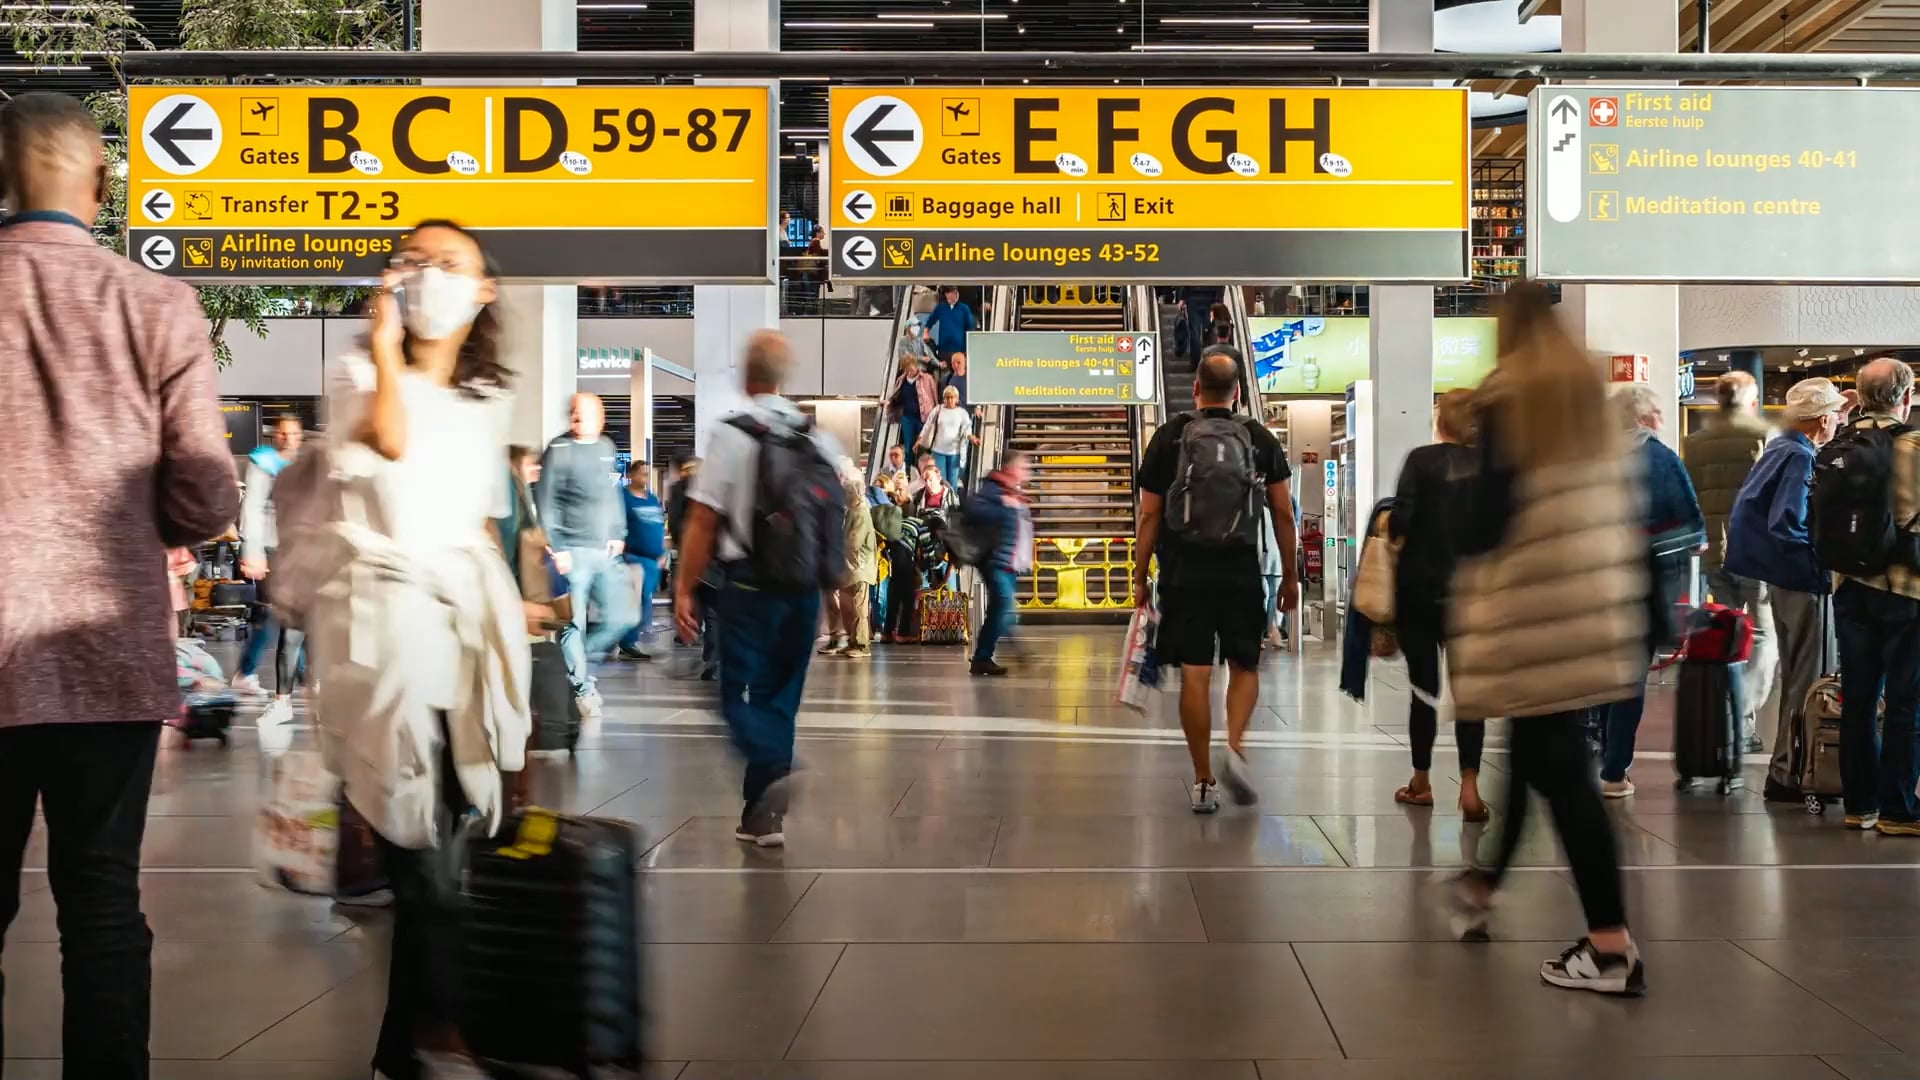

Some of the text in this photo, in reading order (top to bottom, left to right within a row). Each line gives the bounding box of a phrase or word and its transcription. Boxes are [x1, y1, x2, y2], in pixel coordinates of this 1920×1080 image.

[1625, 92, 1712, 112] First aid
[1625, 115, 1704, 130] Eerste hulp
[240, 95, 752, 175] Gates B C D 59-87
[941, 96, 1331, 175] Gates E F G H
[1626, 149, 1857, 173] Airline lounges 40-41
[221, 190, 400, 221] Transfer T2-3
[922, 196, 1062, 218] Baggage hall
[1133, 196, 1174, 214] Exit
[1625, 196, 1821, 215] Meditation centre
[220, 234, 392, 257] Airline lounges
[920, 242, 1160, 266] Airline lounges 43-52
[220, 255, 344, 271] By invitation only
[1069, 334, 1114, 345] First aid
[1075, 345, 1114, 354] Eerste hulp
[579, 356, 631, 369] Service
[996, 357, 1115, 370] Airline lounges 40-41
[1014, 386, 1114, 396] Meditation centre
